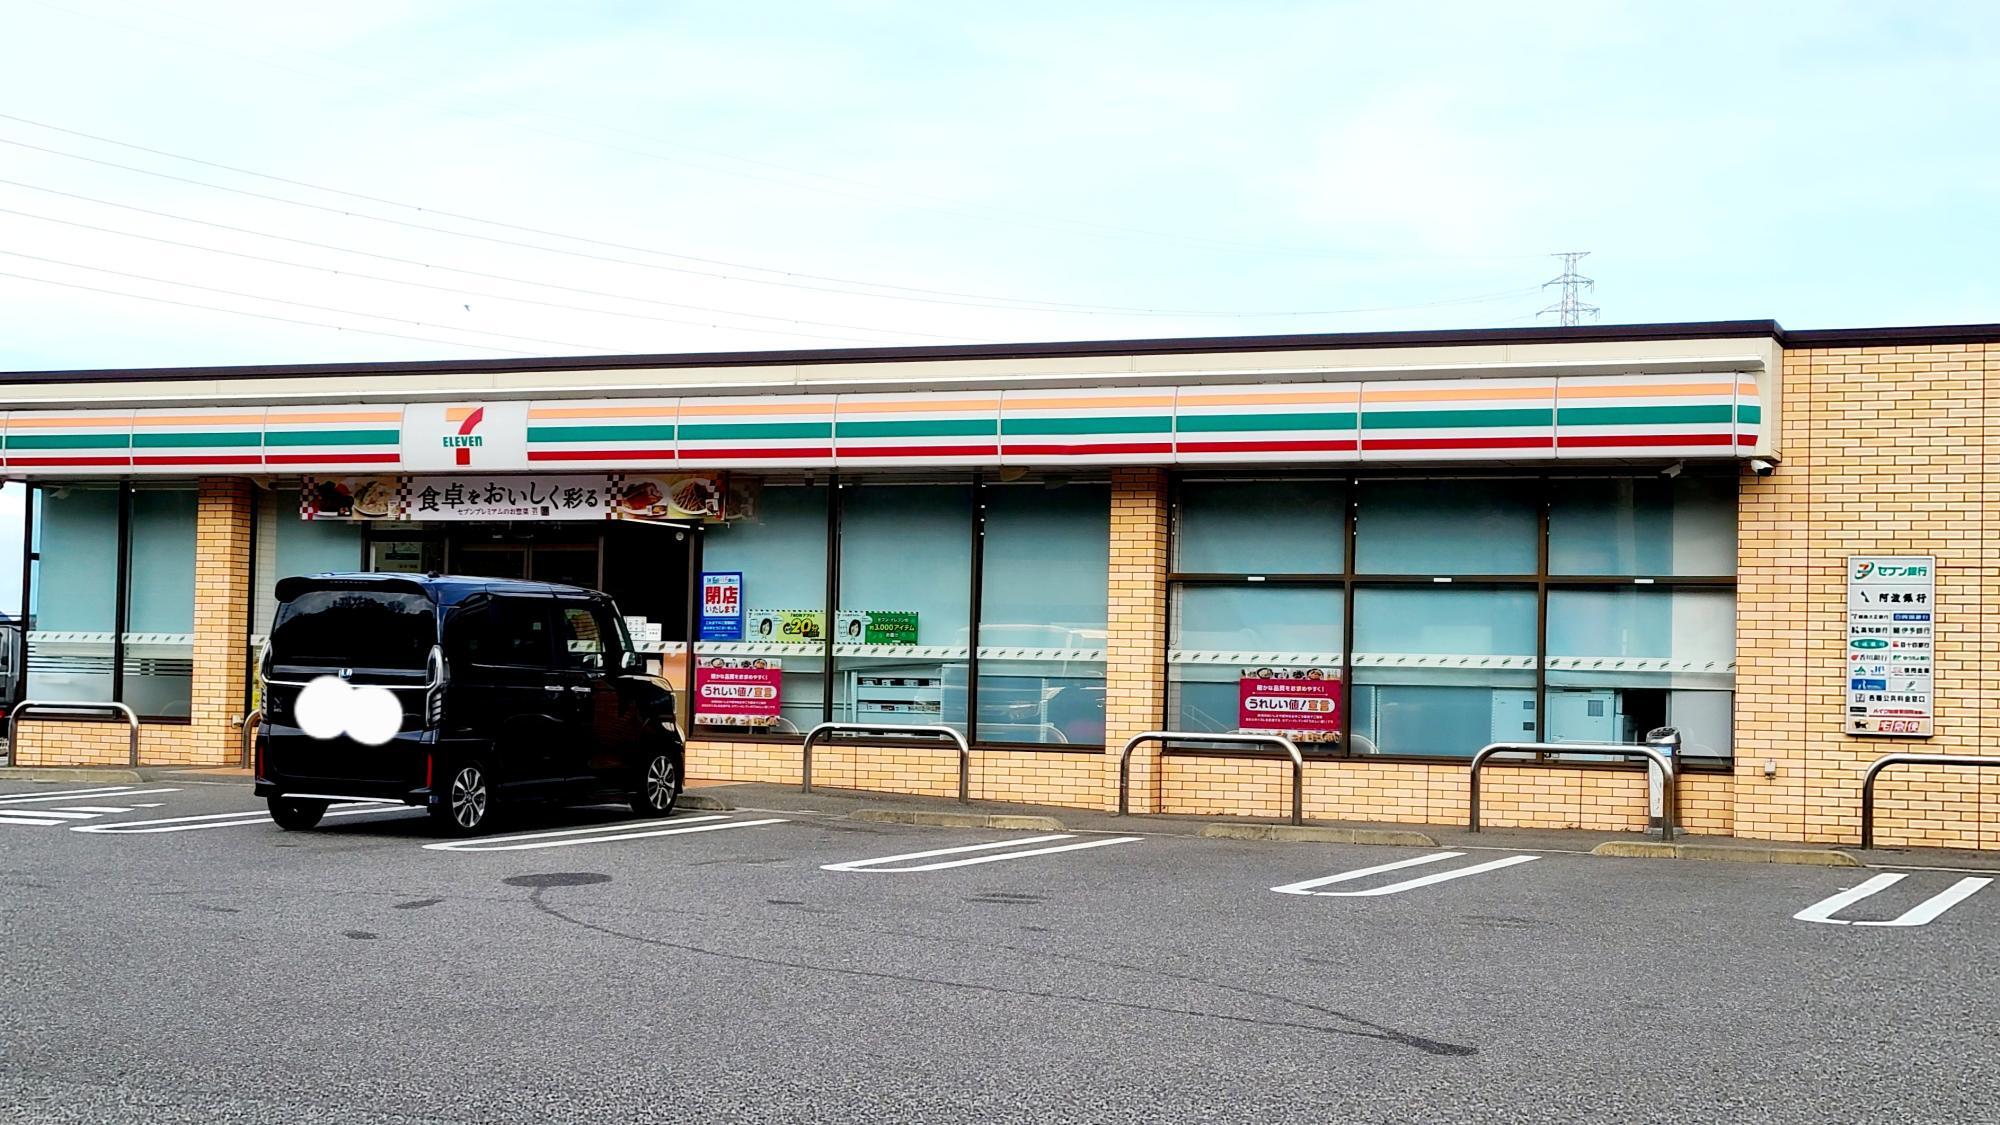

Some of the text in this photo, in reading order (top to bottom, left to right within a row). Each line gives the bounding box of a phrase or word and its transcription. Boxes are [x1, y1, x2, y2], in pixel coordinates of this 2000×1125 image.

[442, 436, 483, 447] ELEVEN
[446, 406, 484, 466] 7
[417, 481, 598, 512] 食卓をおいしく彩る
[1877, 566, 1928, 577] セブン銀行
[705, 585, 738, 605] 閉店
[1878, 593, 1928, 604] 阿波銀行
